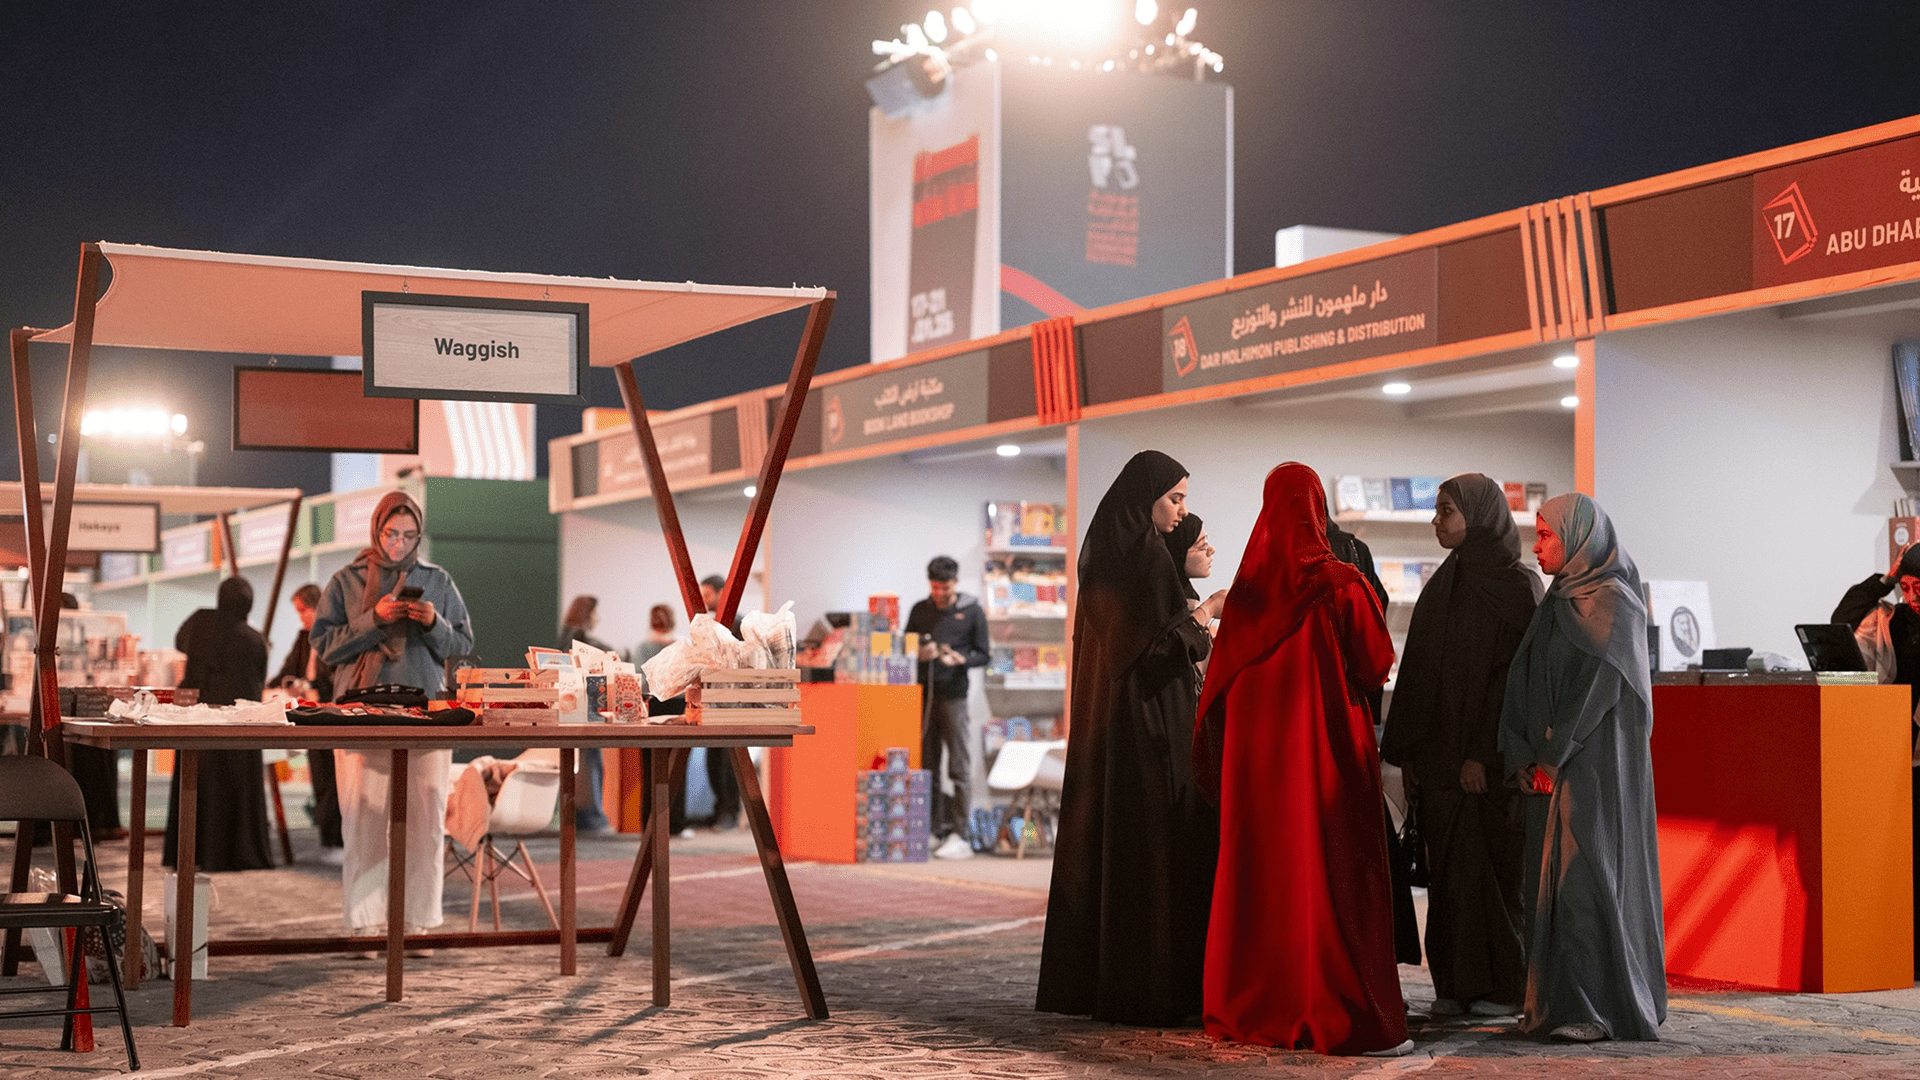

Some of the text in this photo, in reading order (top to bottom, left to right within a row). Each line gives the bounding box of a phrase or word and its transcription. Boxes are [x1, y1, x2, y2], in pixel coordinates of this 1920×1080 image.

[1774, 211, 1795, 240] 17
[1826, 227, 1867, 256] ABU
[1231, 279, 1388, 340] دار ملهمون للنشر والتوزيع
[434, 337, 520, 362] Waggish
[1200, 313, 1425, 370] DAR MOLHIMON PUBLISHING & DISTRIBUTION
